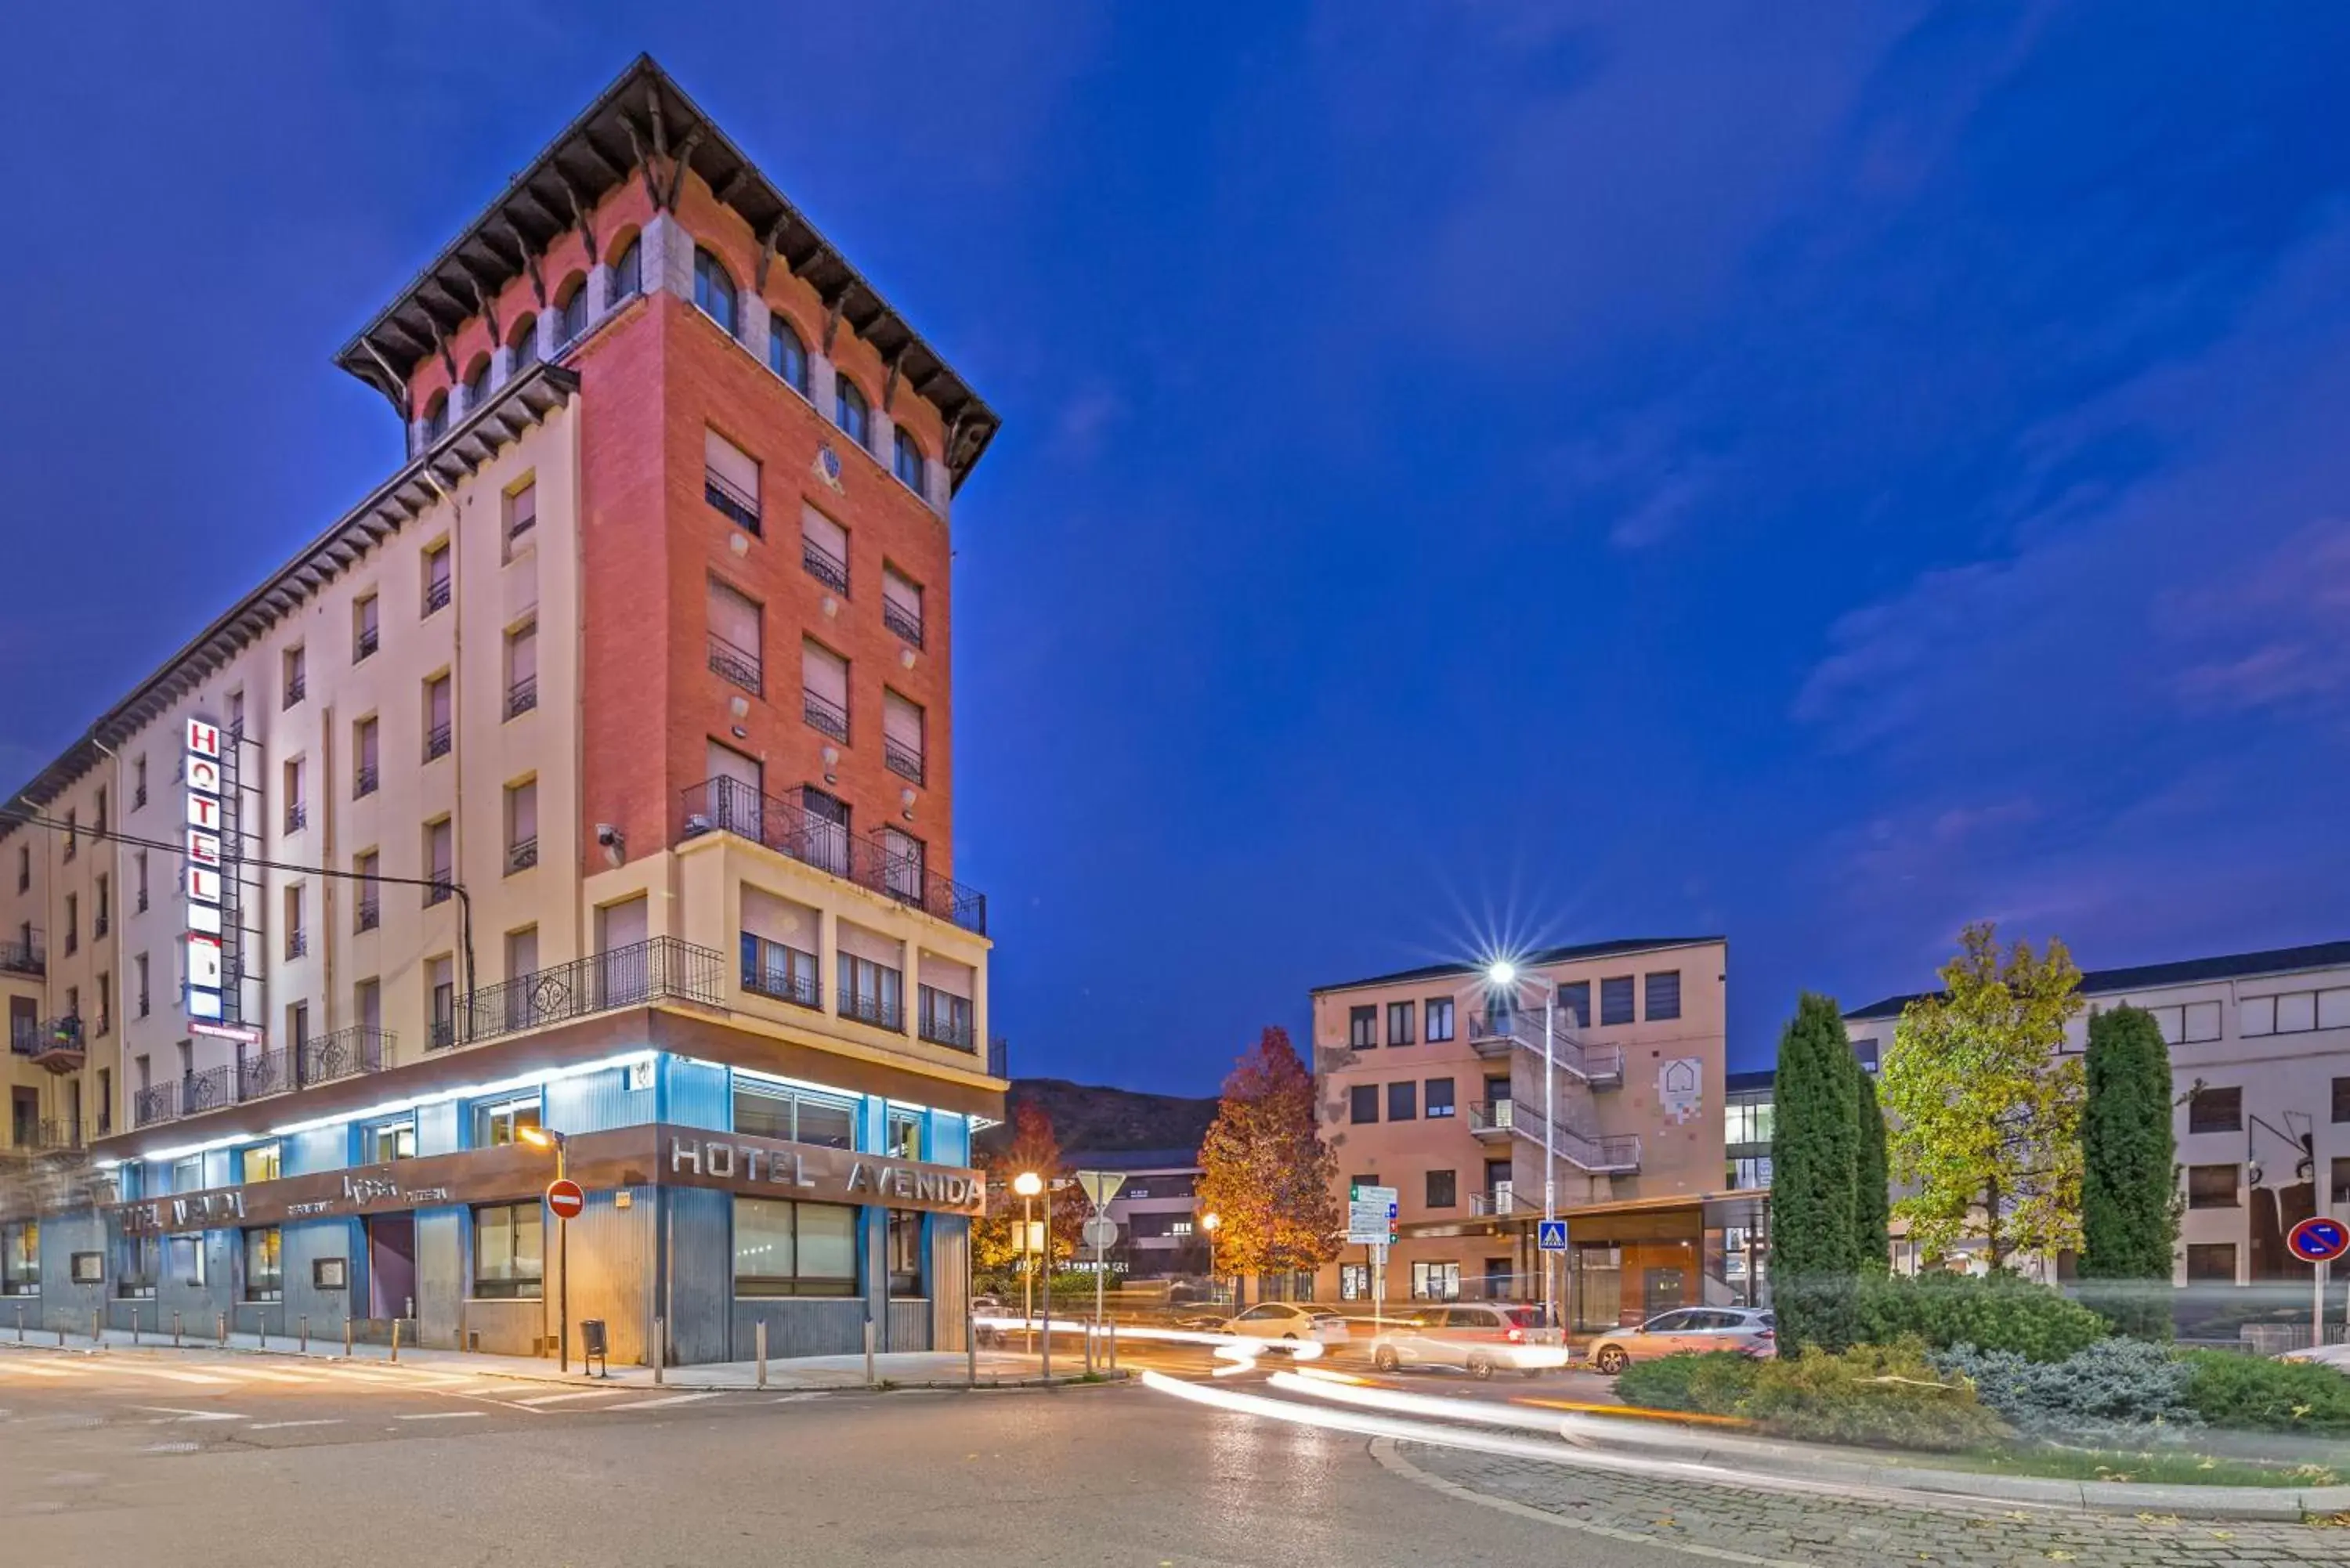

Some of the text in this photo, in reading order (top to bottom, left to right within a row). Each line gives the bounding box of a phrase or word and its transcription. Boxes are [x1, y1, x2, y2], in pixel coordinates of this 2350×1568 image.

[193, 724, 216, 900] HOTEL
[671, 1136, 985, 1206] HOTEL AVENIDA
